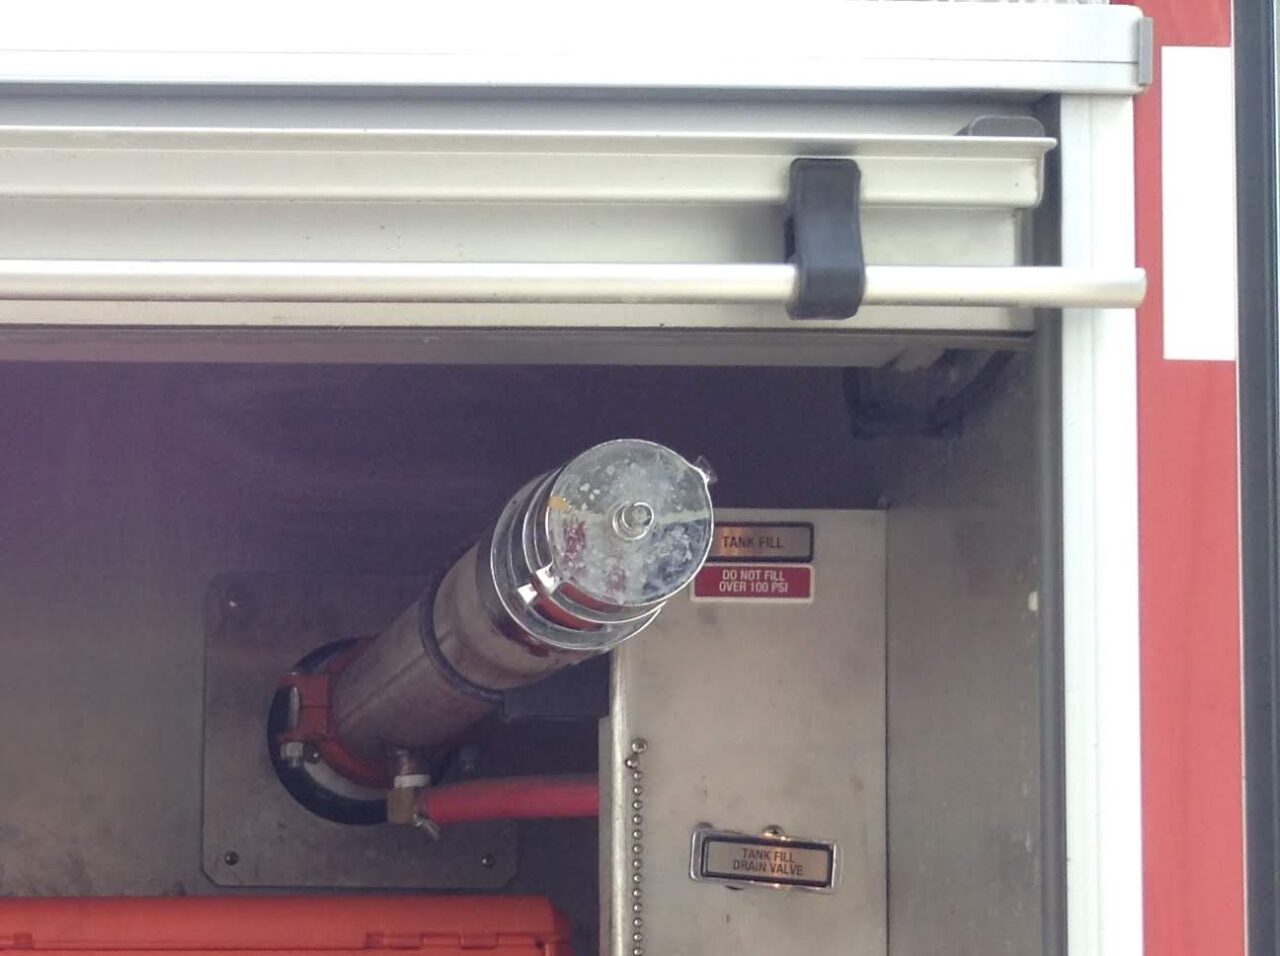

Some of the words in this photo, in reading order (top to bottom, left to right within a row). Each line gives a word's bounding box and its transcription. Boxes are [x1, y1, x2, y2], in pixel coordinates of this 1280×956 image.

[722, 536, 755, 549] TANK
[758, 536, 784, 549] FILL
[722, 569, 738, 580] DO
[740, 569, 762, 581] NOT
[764, 570, 785, 581] FILL
[719, 581, 747, 592] OVER
[750, 581, 769, 592] 100
[770, 582, 788, 593] PSI
[742, 848, 772, 860] TANK
[773, 851, 795, 864] FILL
[732, 859, 767, 873] DRAIN
[769, 862, 804, 876] VALVE
